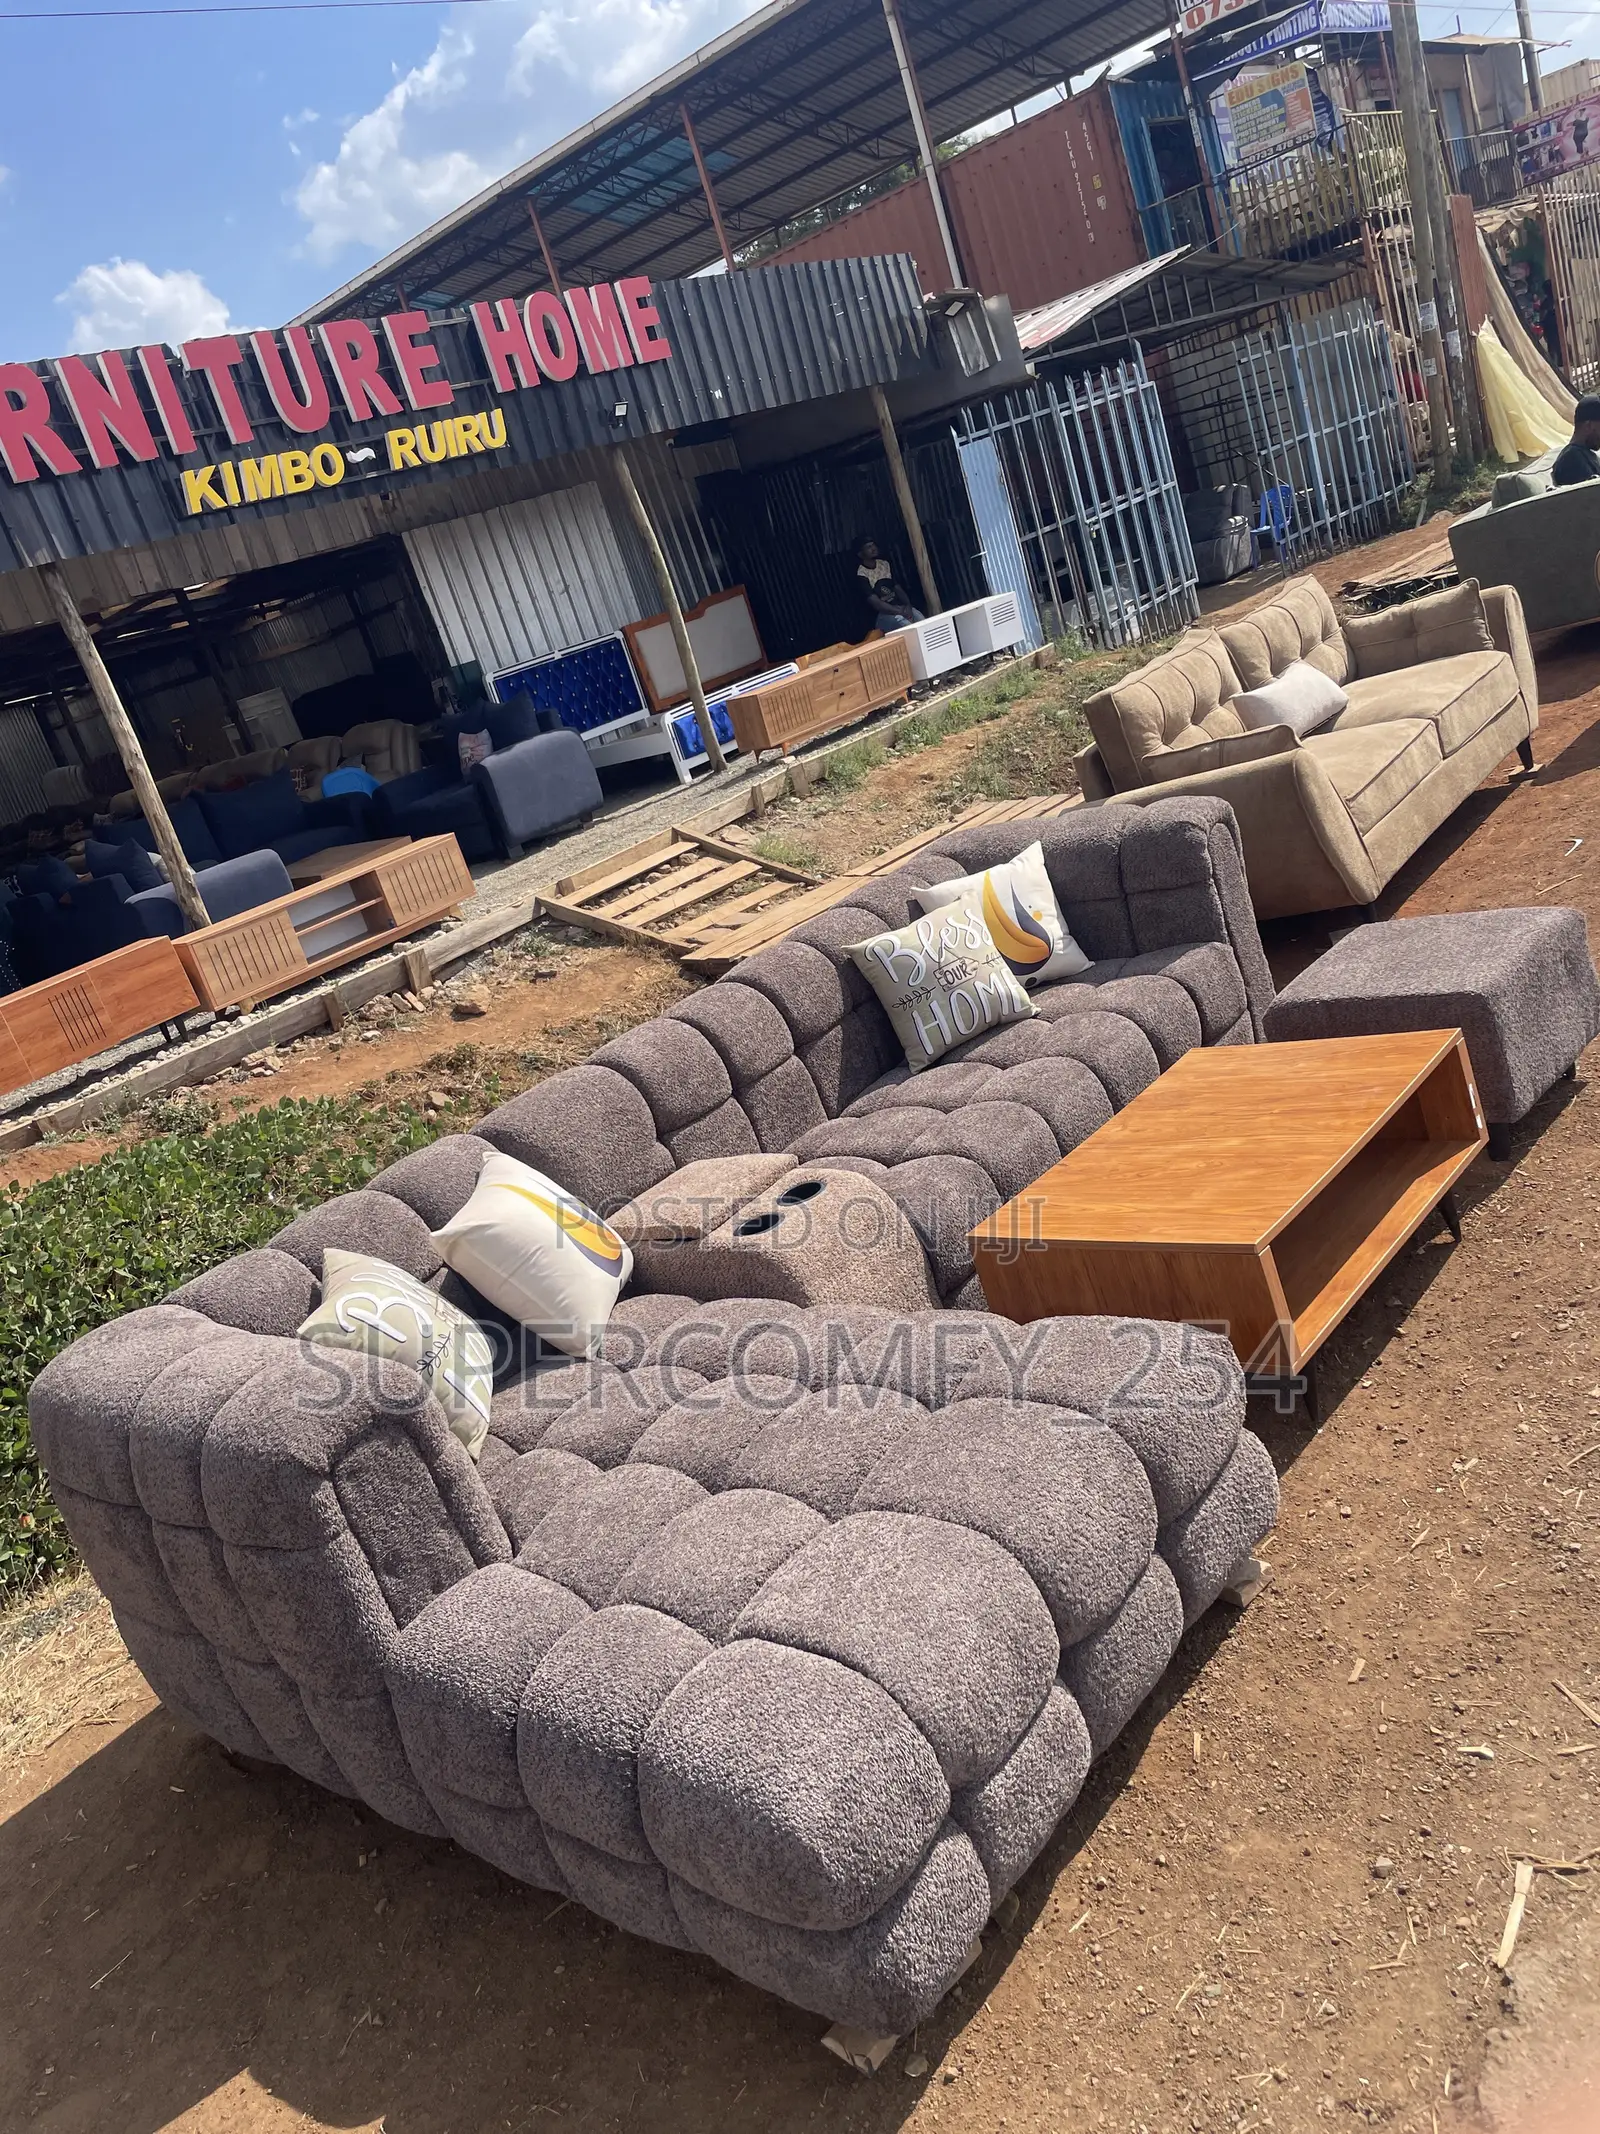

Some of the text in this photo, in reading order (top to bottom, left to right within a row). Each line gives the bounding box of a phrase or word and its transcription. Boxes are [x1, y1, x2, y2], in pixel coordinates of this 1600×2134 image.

[470, 275, 672, 394] HOME
[180, 441, 346, 516] KIMBO
[385, 408, 508, 471] RUIRU
[864, 908, 992, 987] Bless
[943, 960, 972, 986] OUR
